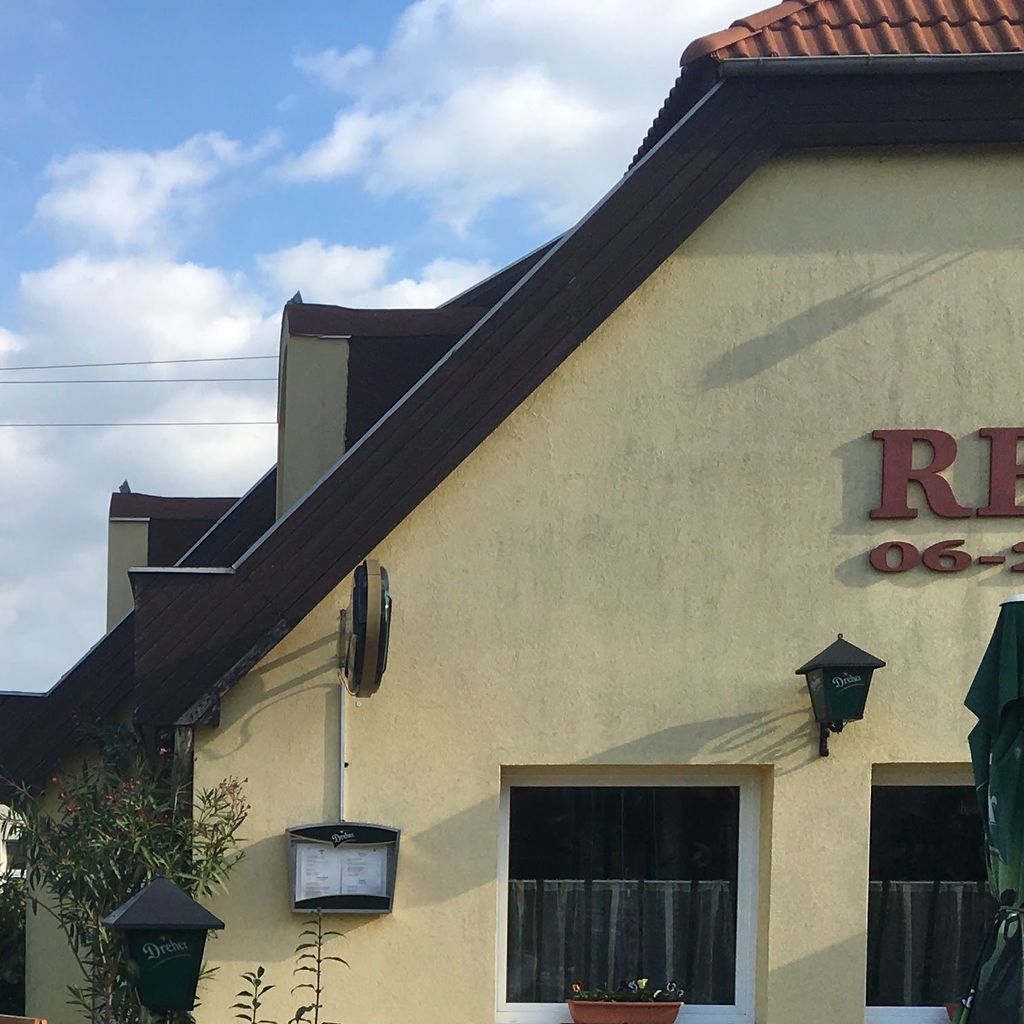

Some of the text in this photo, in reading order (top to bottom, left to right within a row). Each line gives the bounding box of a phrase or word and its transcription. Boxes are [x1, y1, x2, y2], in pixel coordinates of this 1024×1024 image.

[869, 427, 1024, 520] RE
[869, 539, 1024, 573] 06-
[142, 938, 189, 960] Dreher
